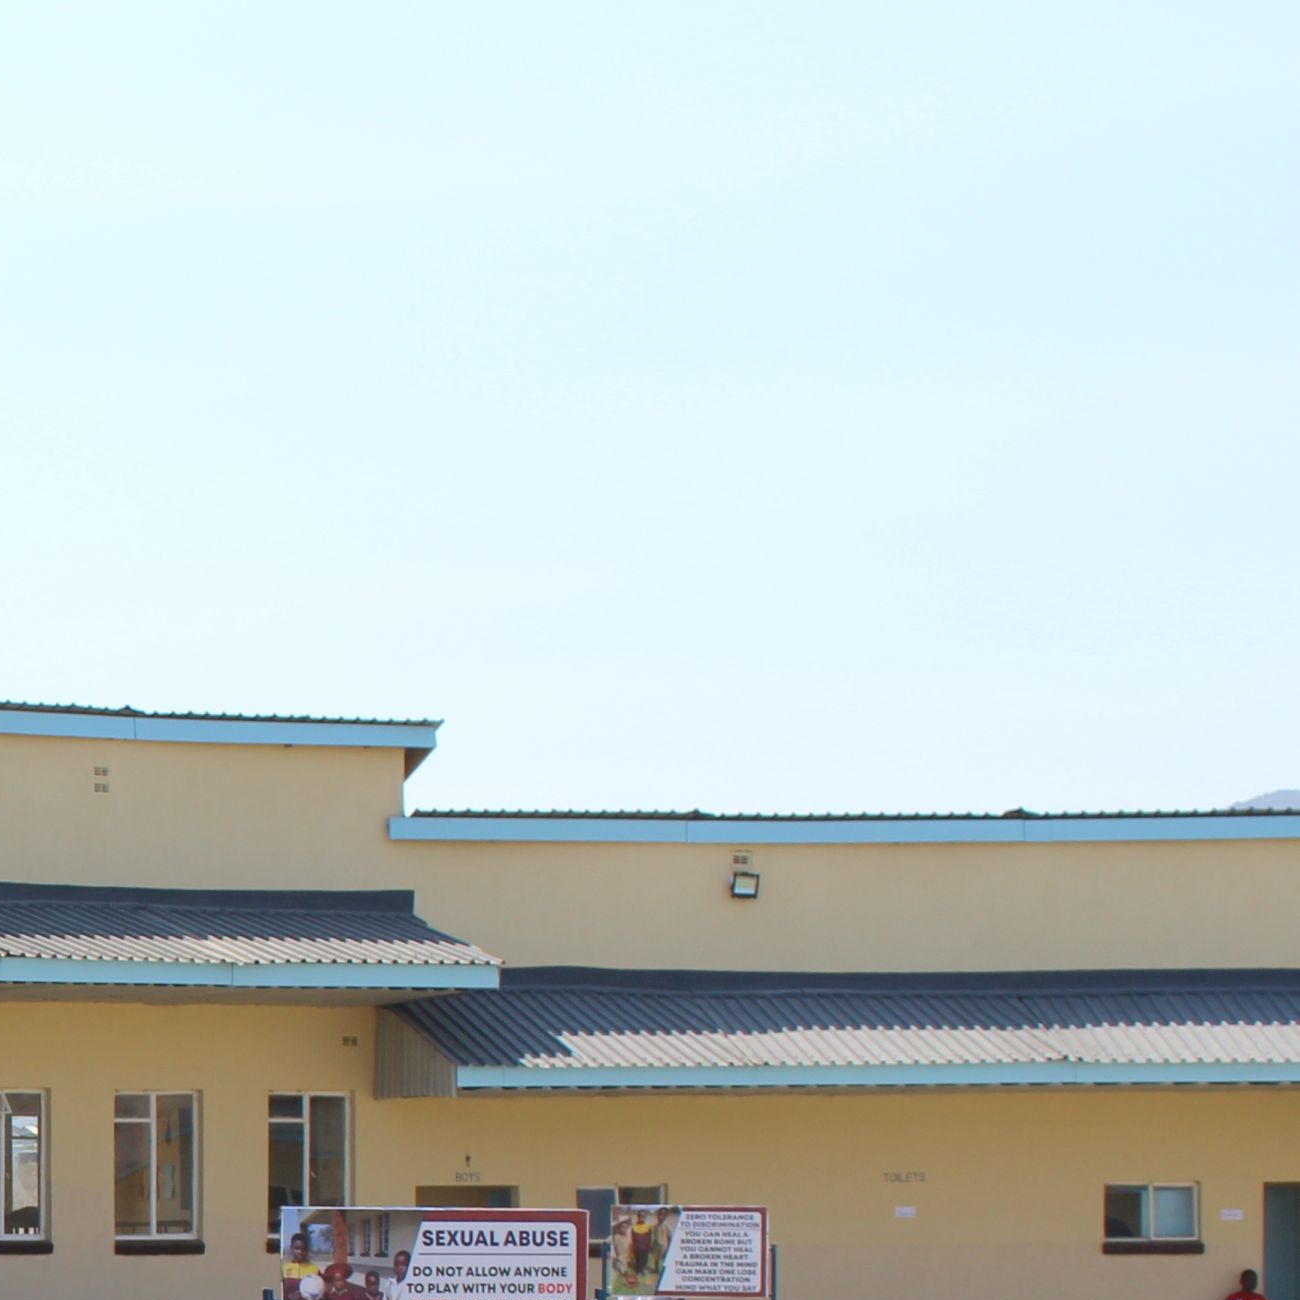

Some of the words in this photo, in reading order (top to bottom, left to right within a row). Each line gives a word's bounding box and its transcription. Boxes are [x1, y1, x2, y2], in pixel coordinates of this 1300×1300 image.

[422, 1230, 499, 1247] SEXUAL
[504, 1231, 569, 1247] ABUSE
[413, 1266, 433, 1277] DO
[436, 1266, 463, 1277] NOT
[466, 1267, 511, 1277] ALLOW
[514, 1267, 568, 1277] ANYONE
[407, 1283, 425, 1293] TO
[428, 1283, 459, 1293] PLAY
[463, 1283, 496, 1293] WITH
[500, 1283, 535, 1293] YOUR
[538, 1283, 572, 1293] BODY
